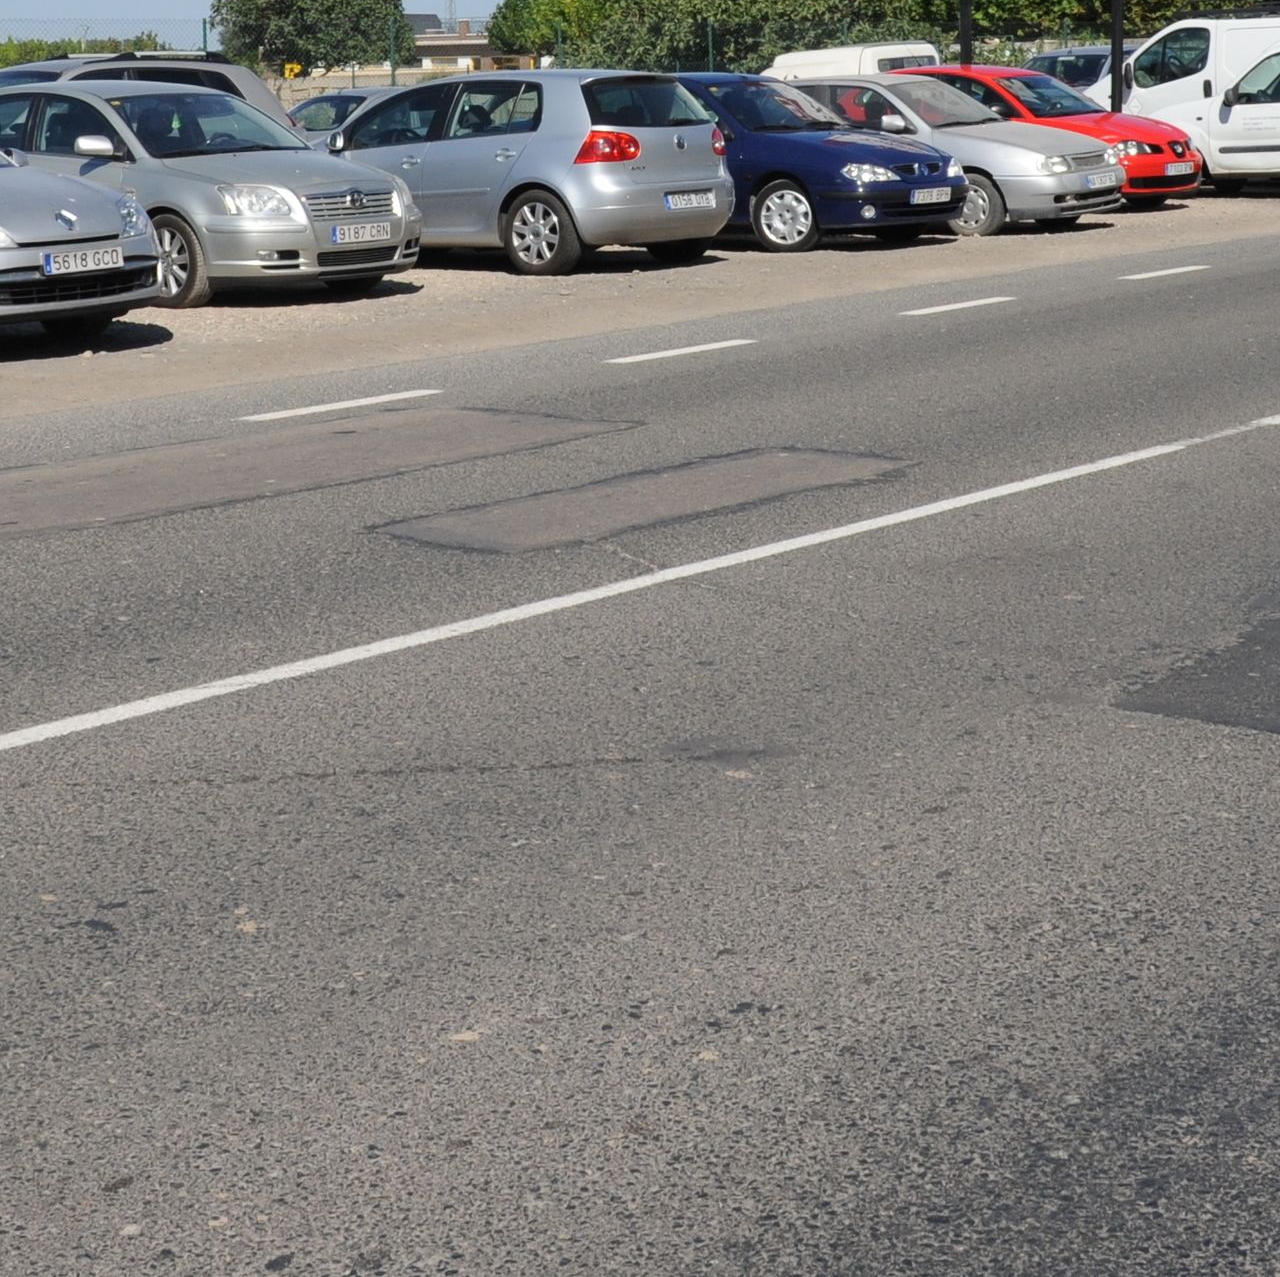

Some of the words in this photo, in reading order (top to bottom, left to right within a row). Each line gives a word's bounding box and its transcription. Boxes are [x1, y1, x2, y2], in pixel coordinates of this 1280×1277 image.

[339, 225, 367, 241] 9187
[369, 224, 389, 238] CRN
[53, 252, 88, 271] 5618
